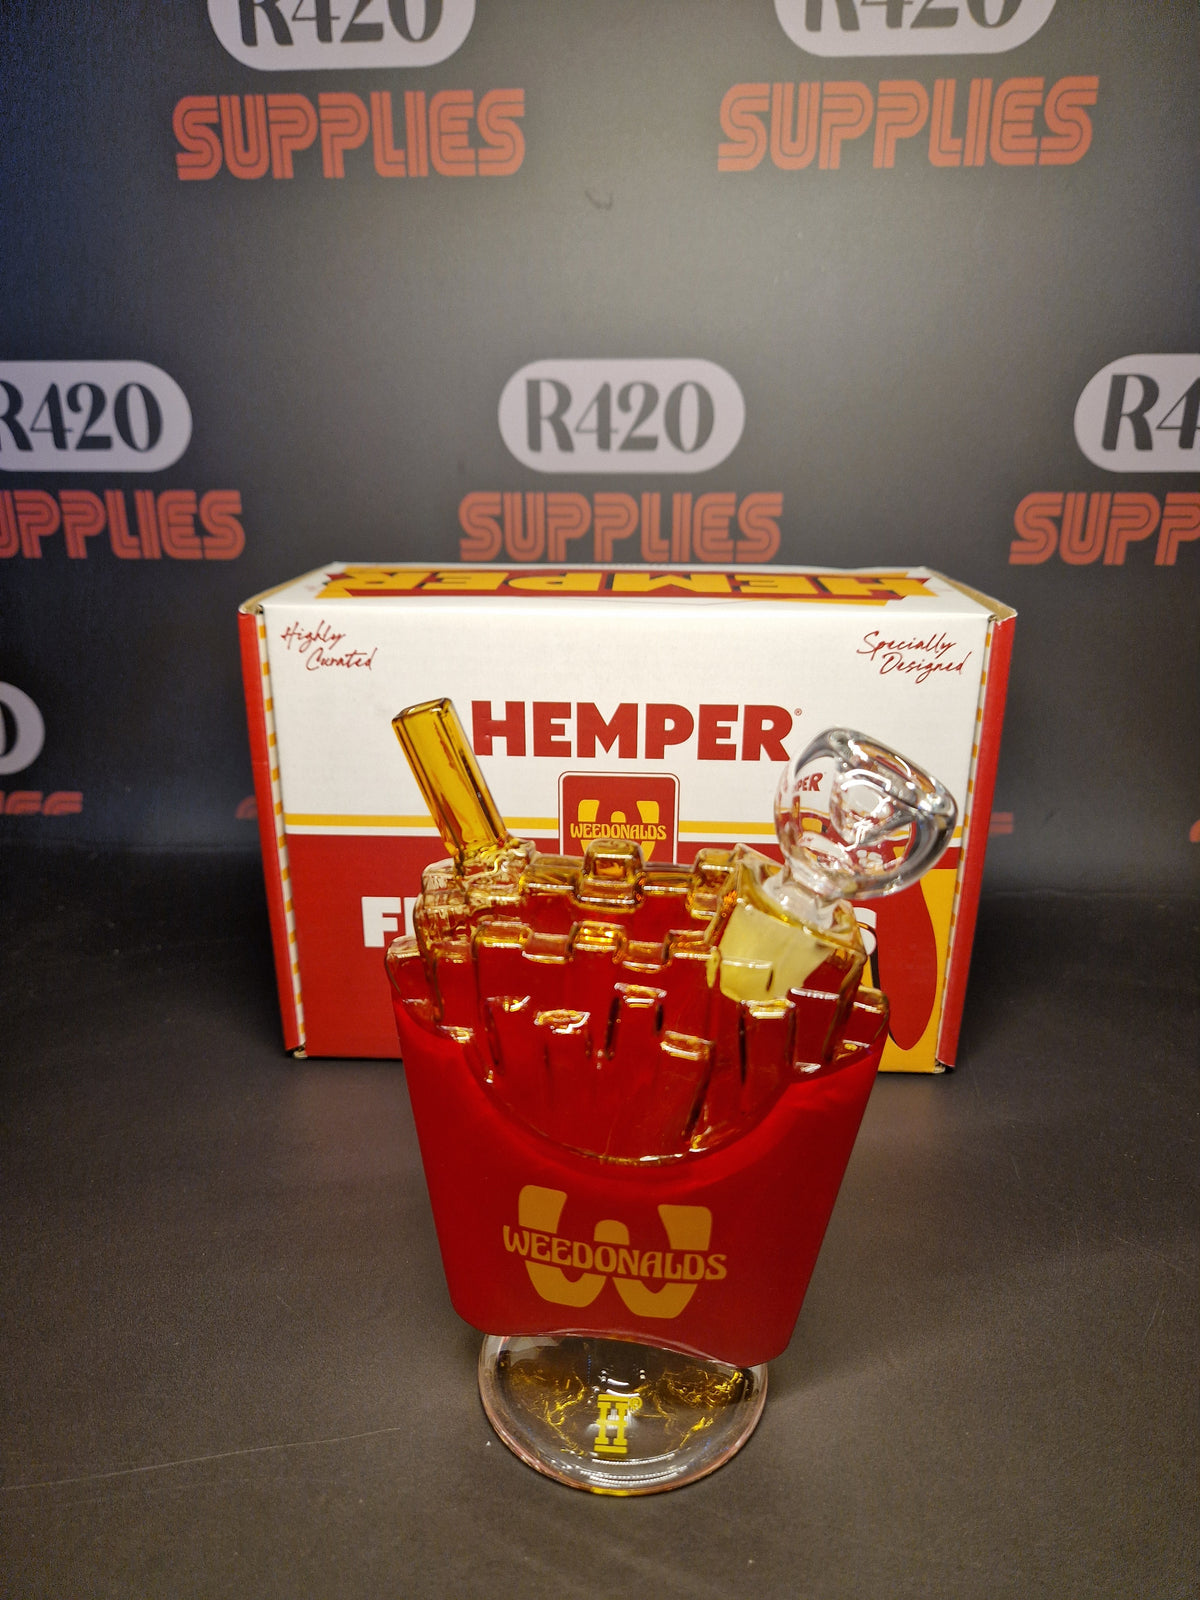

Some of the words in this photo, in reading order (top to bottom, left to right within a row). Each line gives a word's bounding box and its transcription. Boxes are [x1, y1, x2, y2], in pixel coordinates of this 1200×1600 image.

[172, 89, 525, 181] SUPPLIES
[717, 76, 1099, 172] SUPPLIES
[525, 377, 715, 453] R420
[458, 492, 784, 562] SUPPLIES
[322, 569, 938, 598] HEMPER
[281, 619, 346, 653] Highly
[856, 630, 957, 661] Specially
[305, 646, 378, 671] Curated
[880, 651, 972, 684] Designed
[570, 823, 667, 840] WEEDONALDS
[503, 1225, 727, 1280] WEEDONALDS
